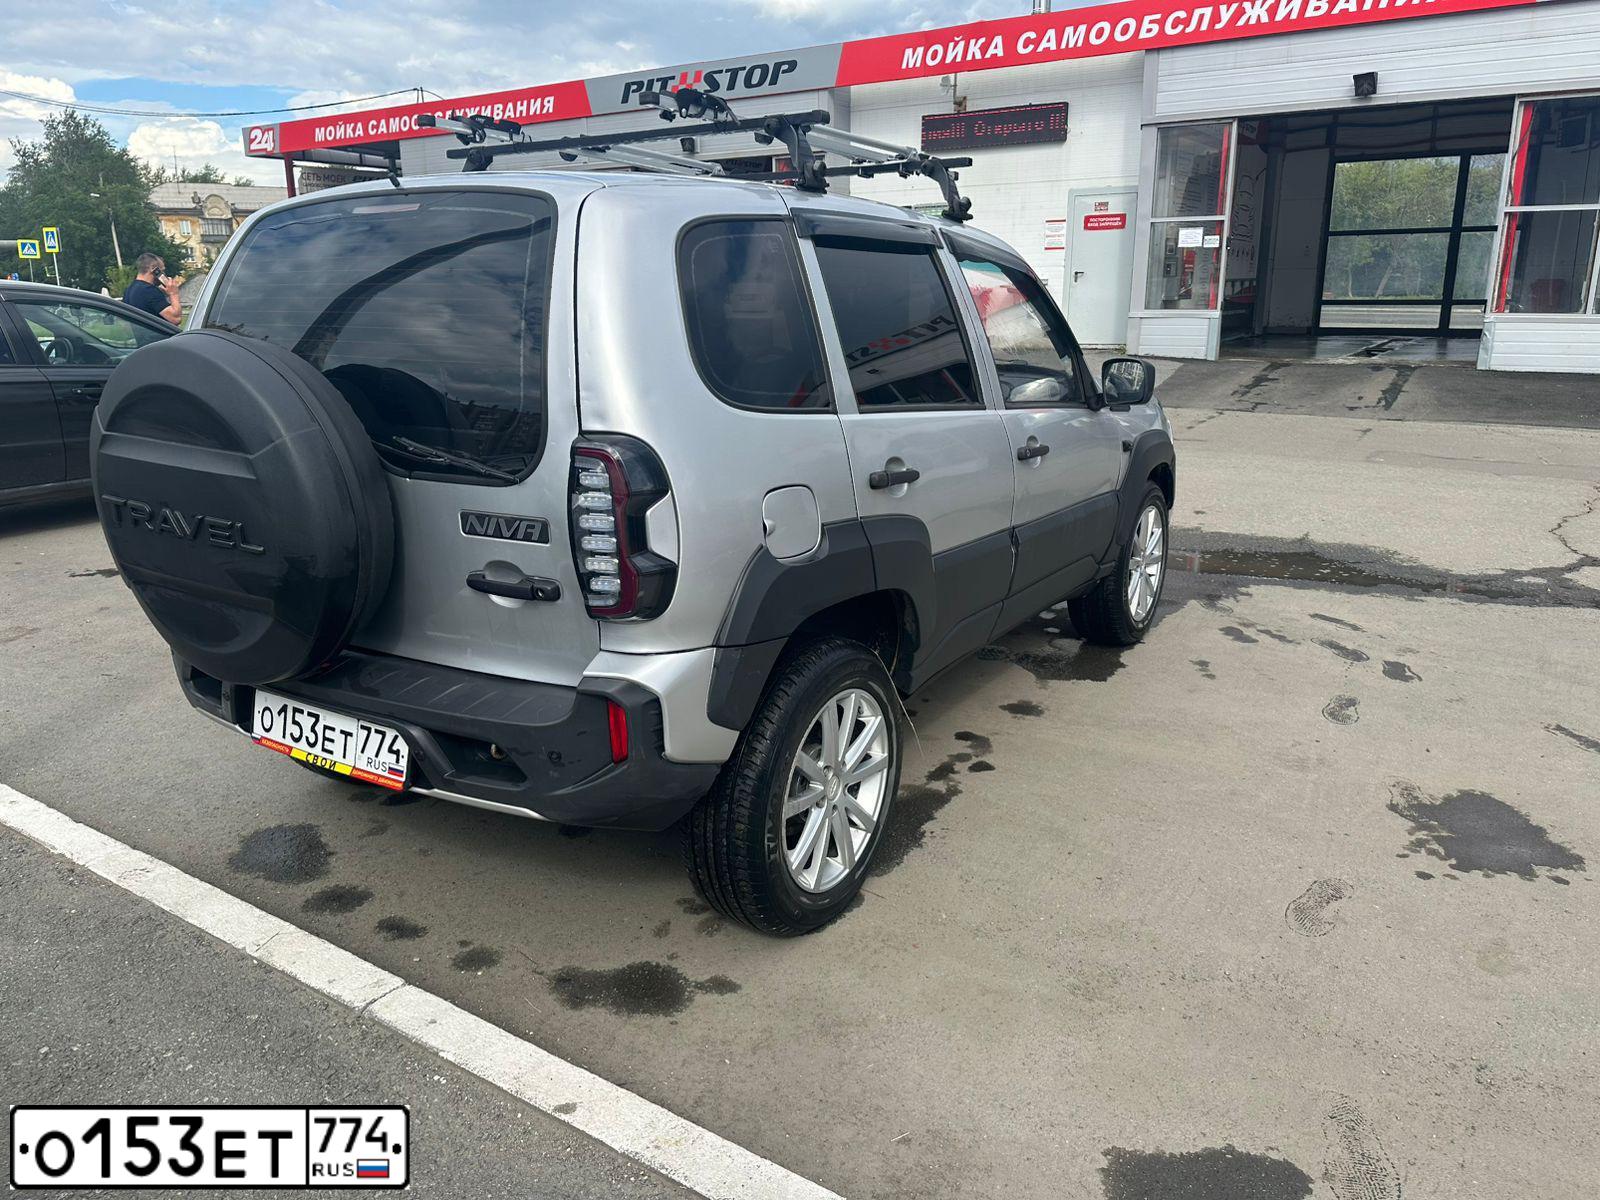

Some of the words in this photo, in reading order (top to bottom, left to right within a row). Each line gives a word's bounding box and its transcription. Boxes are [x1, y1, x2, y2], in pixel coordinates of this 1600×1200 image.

[901, 36, 1004, 69] МОЙКА
[620, 75, 676, 104] PIT
[702, 59, 798, 93] STOP
[249, 127, 275, 153] 24
[315, 121, 364, 142] МОЙКА
[101, 494, 265, 554] TRAVEL
[465, 514, 542, 541] NIVA
[360, 724, 401, 764] 774
[366, 756, 388, 773] RUS
